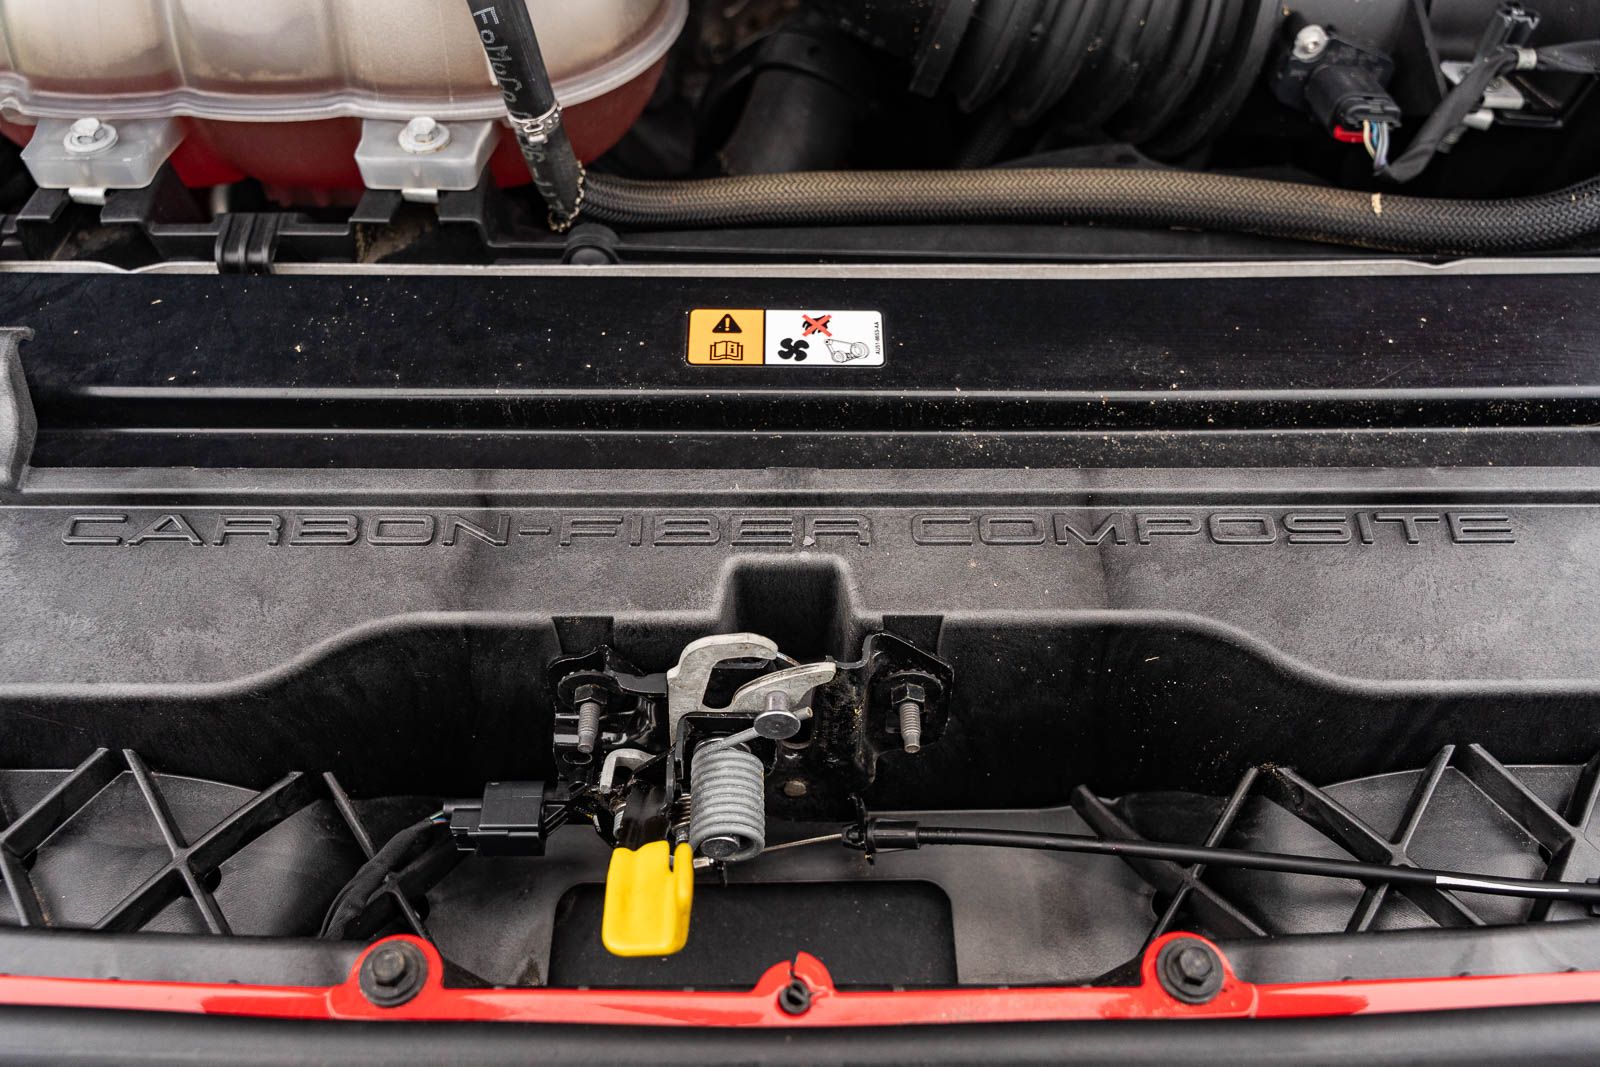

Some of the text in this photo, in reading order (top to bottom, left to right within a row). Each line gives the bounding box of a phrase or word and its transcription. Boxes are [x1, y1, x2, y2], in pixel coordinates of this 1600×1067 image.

[473, 6, 523, 103] FoMoCo
[61, 513, 1516, 547] CARBON-FIBER COMPOSITE
